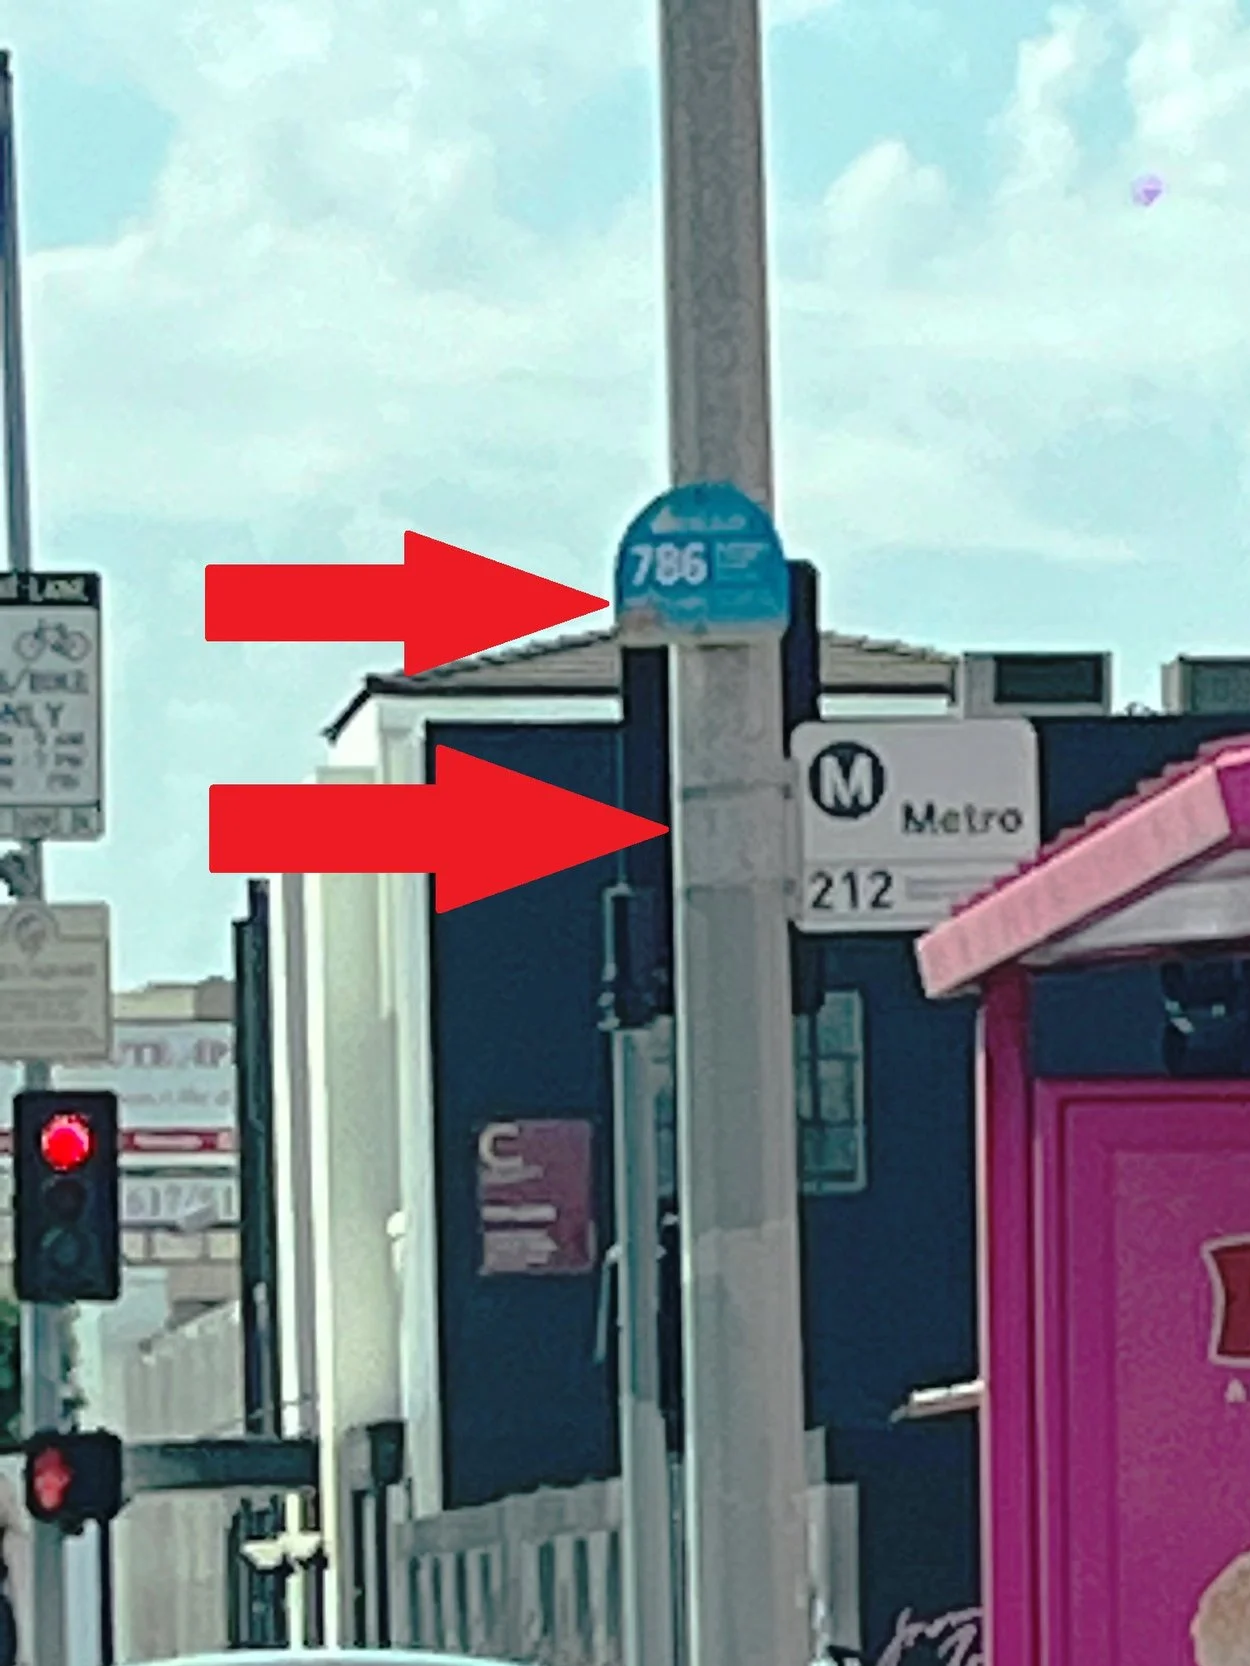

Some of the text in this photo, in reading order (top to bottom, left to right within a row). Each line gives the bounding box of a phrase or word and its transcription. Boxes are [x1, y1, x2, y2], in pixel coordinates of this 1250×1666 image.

[627, 541, 709, 587] 786
[818, 751, 876, 811] M
[902, 800, 1023, 835] Metro
[809, 870, 893, 910] 212
[1225, 1378, 1247, 1403] A
